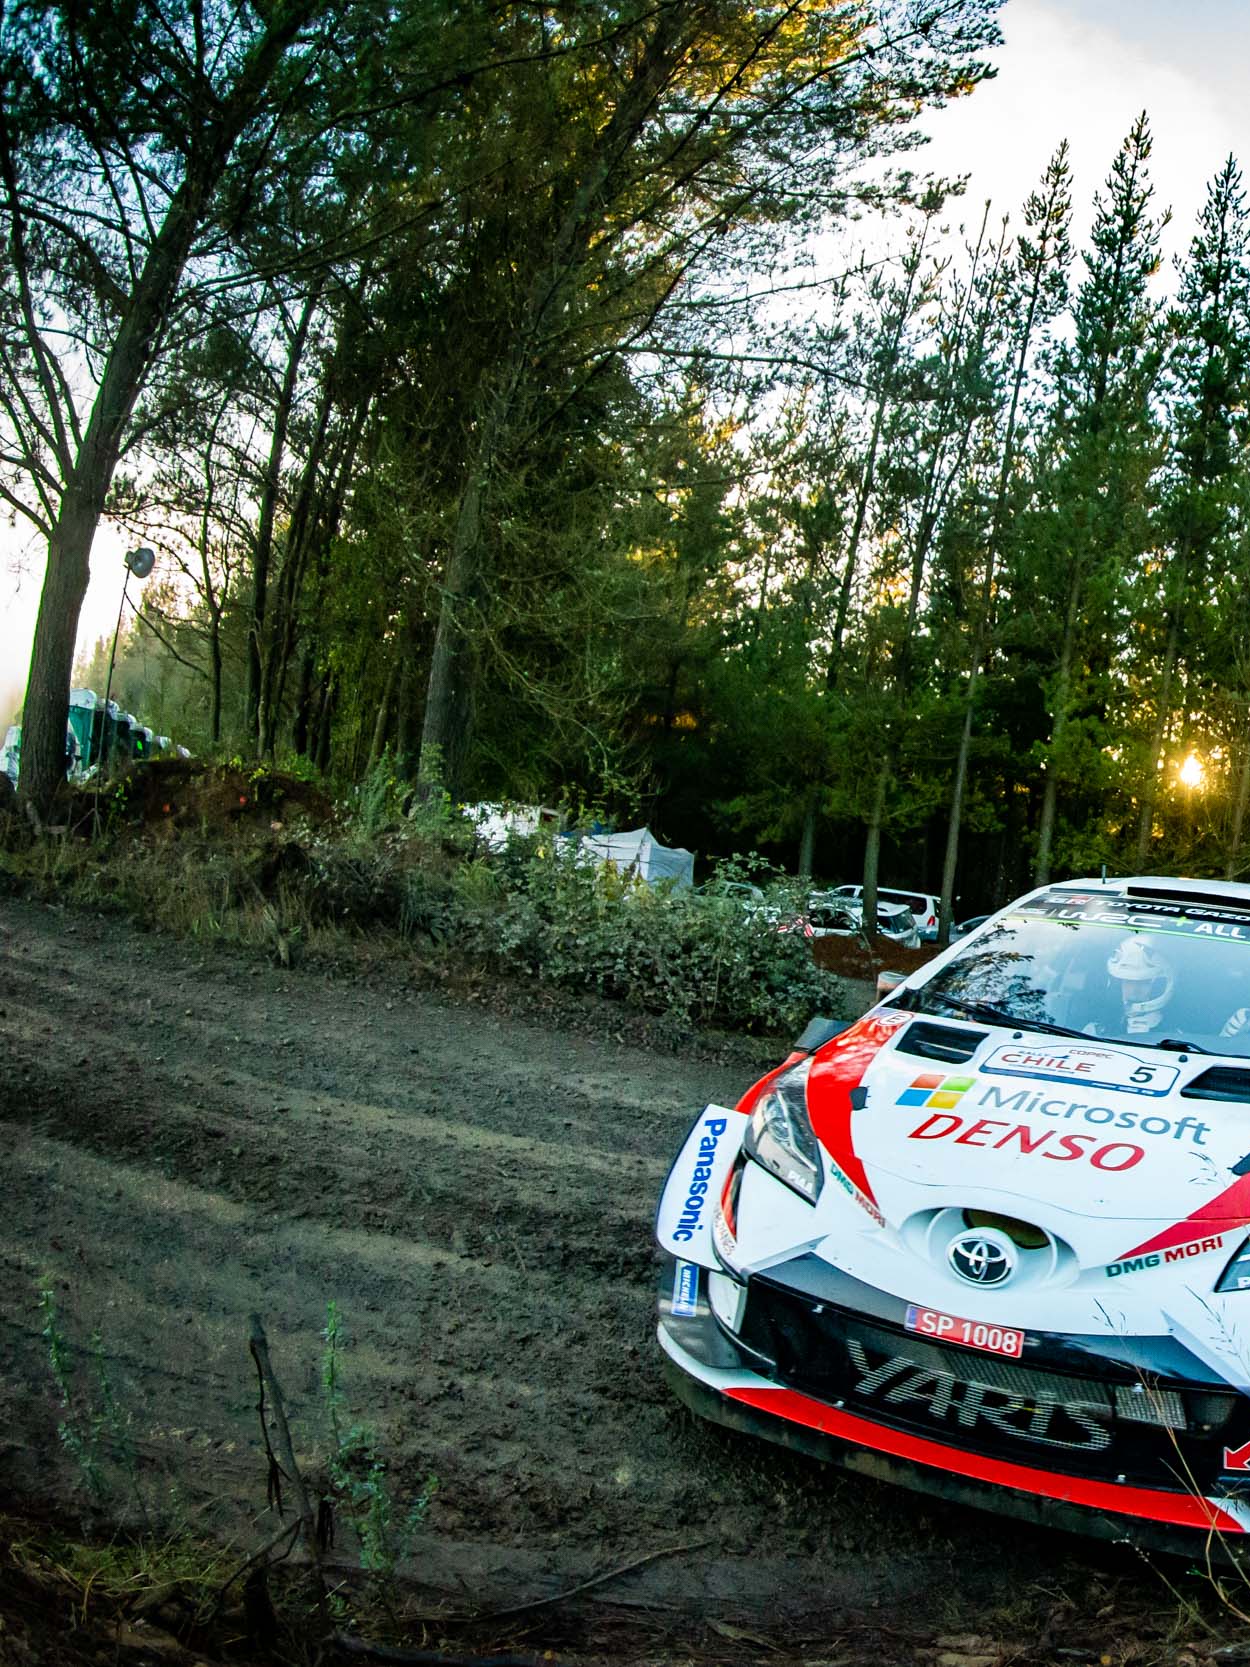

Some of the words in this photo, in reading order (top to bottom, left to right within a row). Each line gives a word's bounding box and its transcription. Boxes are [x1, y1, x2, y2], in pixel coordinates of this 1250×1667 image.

[1095, 900, 1181, 913] TOYOTA
[1194, 921, 1246, 939] ALL
[1001, 1053, 1096, 1073] CHILE
[1129, 1066, 1157, 1084] 5
[977, 1086, 1212, 1146] Microsoft
[907, 1113, 1145, 1172] DENSO
[672, 1118, 728, 1243] Panasonic
[1106, 1253, 1161, 1278] DMG
[1164, 1235, 1224, 1263] MORI
[920, 1311, 954, 1336] SP
[961, 1321, 1018, 1354] 1008
[847, 1339, 1112, 1451] YARIS
